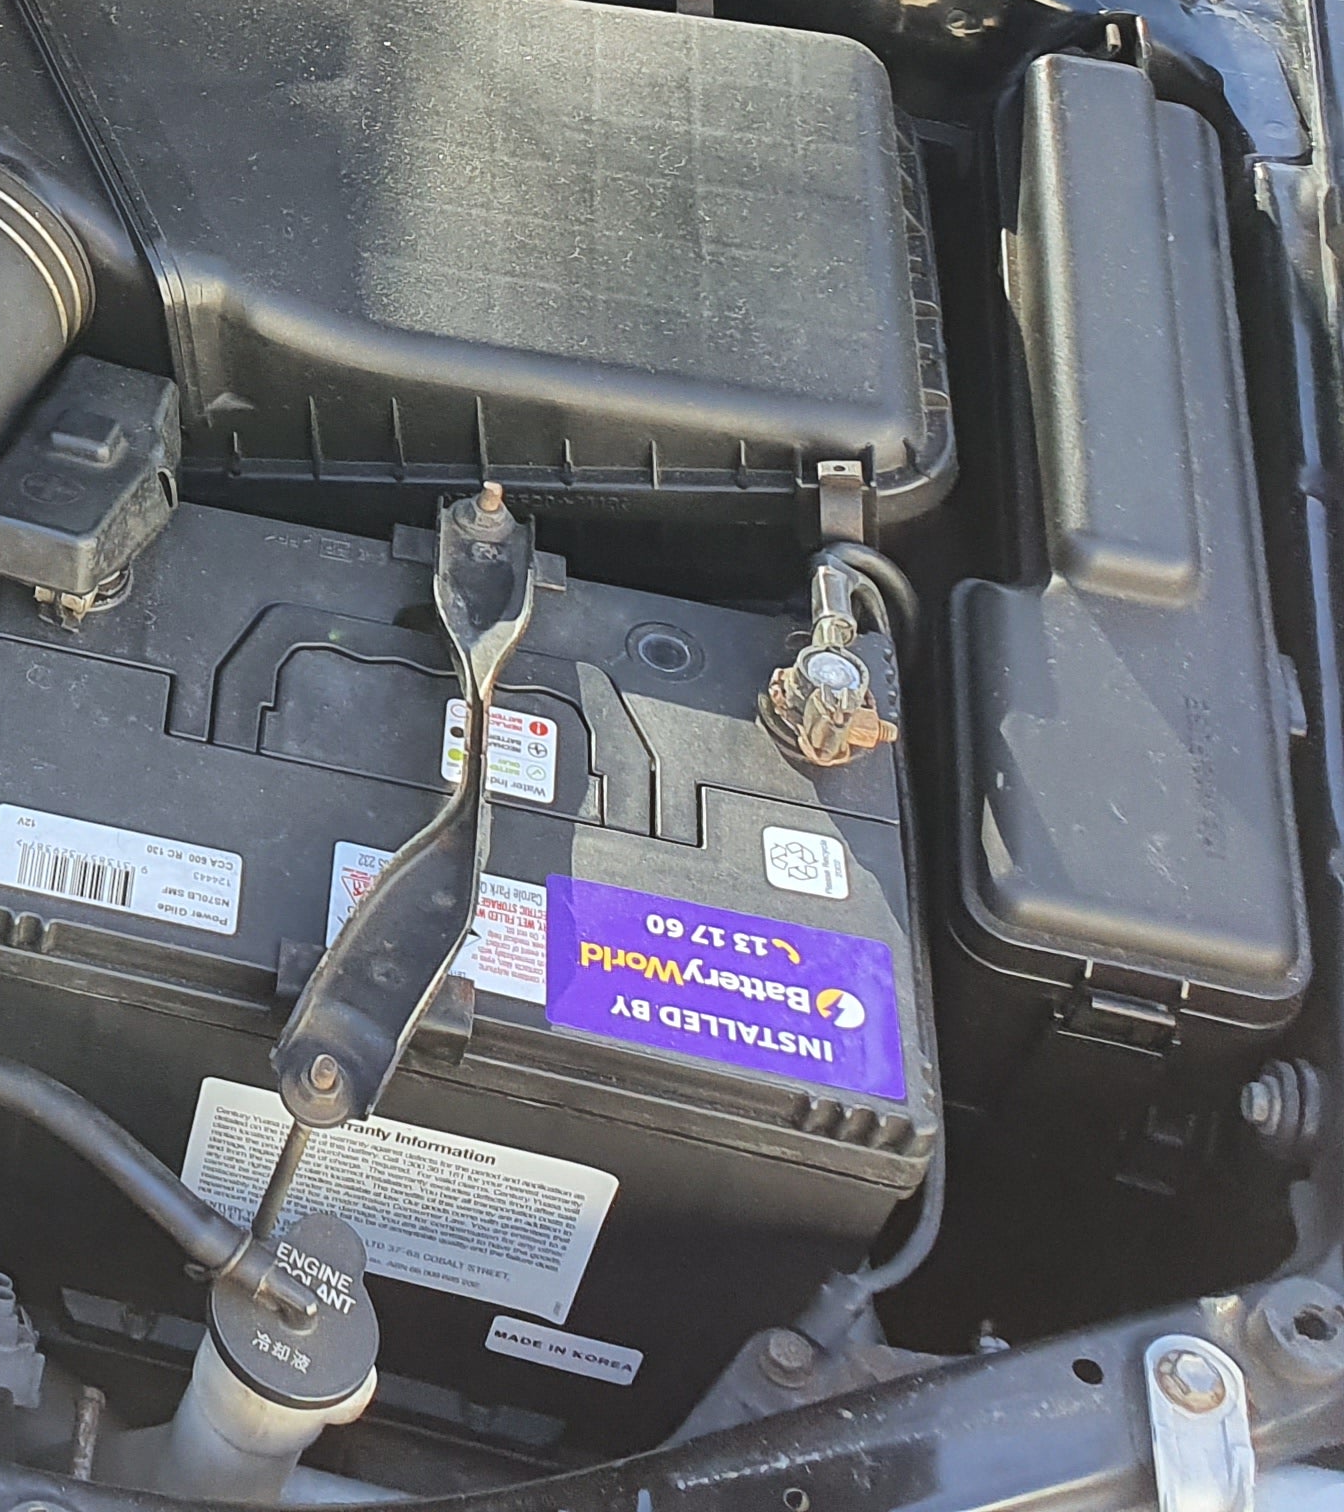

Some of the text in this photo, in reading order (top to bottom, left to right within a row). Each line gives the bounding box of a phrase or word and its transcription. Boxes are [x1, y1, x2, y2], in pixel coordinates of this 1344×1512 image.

[489, 711, 522, 723] BATTER
[489, 719, 522, 731] REPLAC
[488, 733, 521, 745] BATTER
[489, 763, 519, 776] BATTER
[511, 780, 545, 796] Water
[16, 816, 35, 828] 12V
[146, 844, 164, 855] 130
[166, 848, 182, 859] RC
[819, 839, 830, 867] Recycle
[209, 857, 233, 871] CCA
[357, 853, 375, 868] 232
[160, 884, 184, 897] SMF
[489, 883, 510, 898] Park
[513, 888, 542, 905] Carole
[479, 895, 517, 913] STORAGE
[156, 901, 228, 926] Power Glide
[487, 909, 514, 925] FILLED
[487, 928, 502, 940] help
[503, 933, 529, 947] medical
[646, 912, 767, 957] 13 17 60
[579, 935, 811, 1014] BatteryWorld
[610, 993, 833, 1062] INSTALLED BY
[336, 1118, 497, 1166] rranty Information
[275, 1240, 353, 1294] ENGINE
[421, 1253, 465, 1270] COBALT
[250, 1329, 312, 1374] 冷却液
[493, 1329, 634, 1373] MADE IN KOREA
